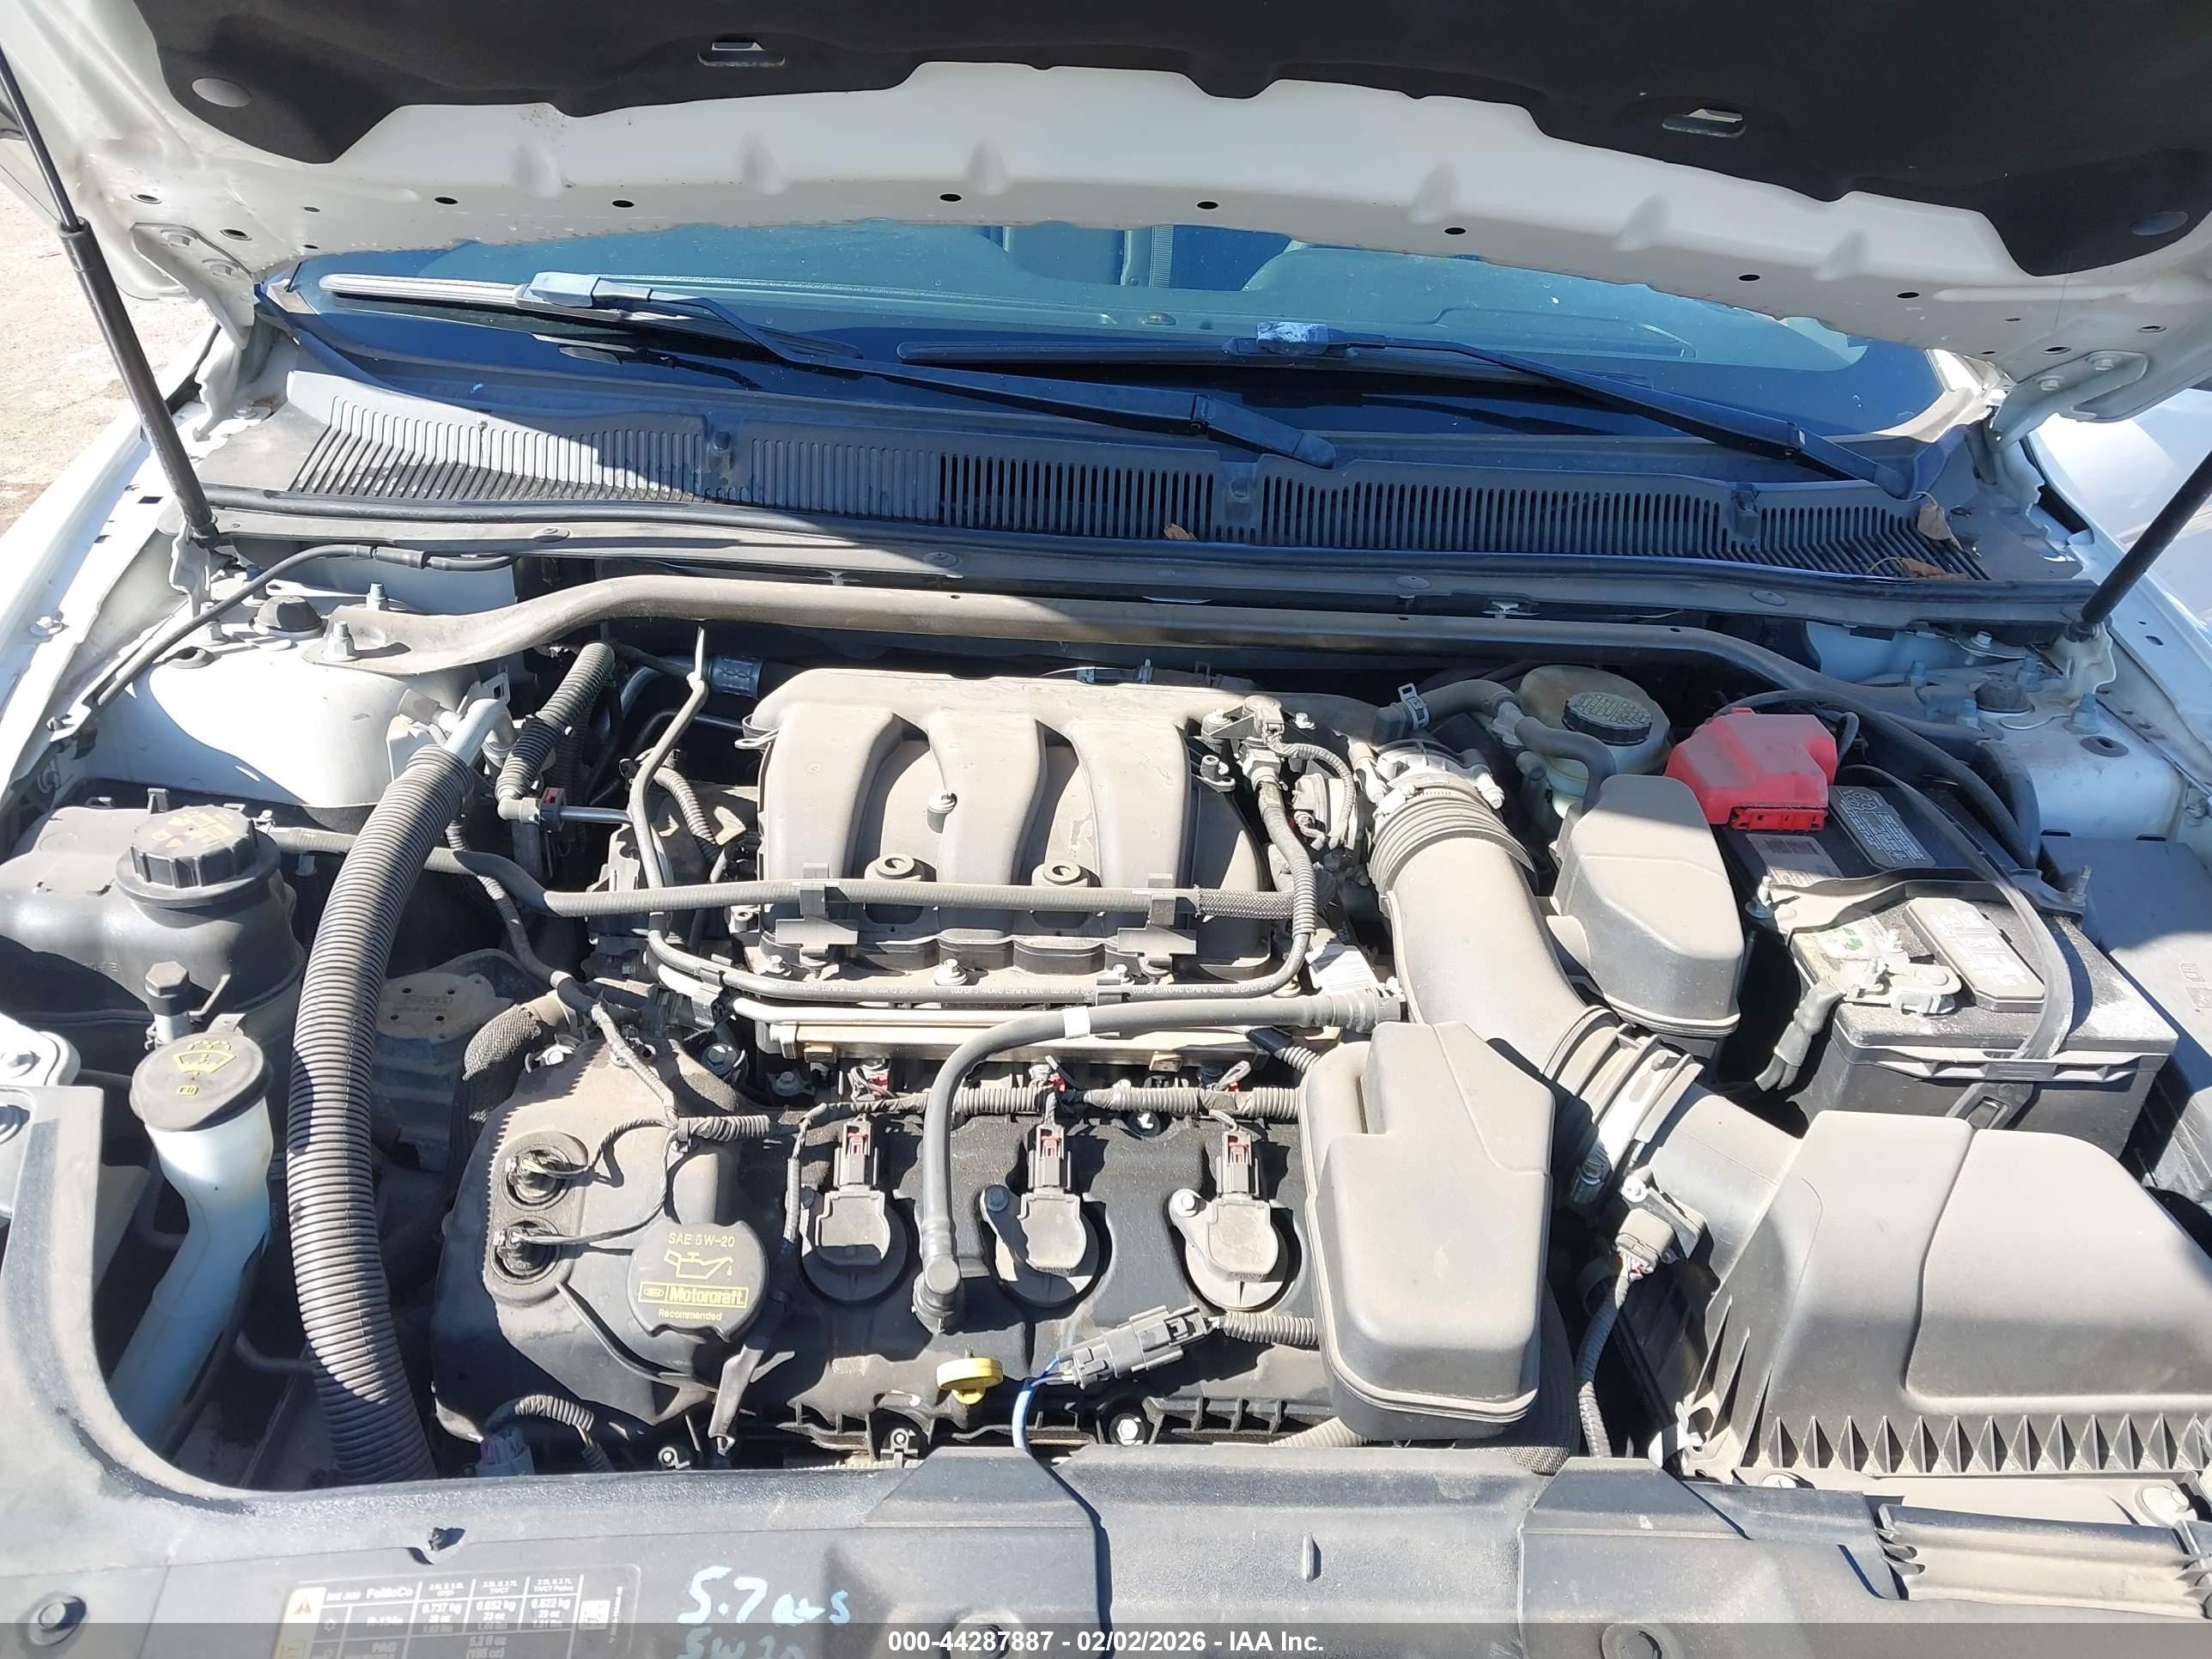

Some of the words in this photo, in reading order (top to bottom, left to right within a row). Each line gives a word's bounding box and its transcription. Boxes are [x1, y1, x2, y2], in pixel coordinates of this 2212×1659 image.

[667, 1232, 692, 1245] SAE
[695, 1234, 736, 1249] 5W-20
[658, 1308, 723, 1322] Recommended
[366, 1586, 414, 1599] FoMoCo
[678, 1565, 768, 1624] 5.7
[449, 1602, 462, 1614] kg
[503, 1600, 517, 1612] kg
[558, 1597, 571, 1610] kg
[372, 1642, 398, 1654] PAG
[468, 1636, 484, 1647] 5.2
[494, 1636, 507, 1646] oz
